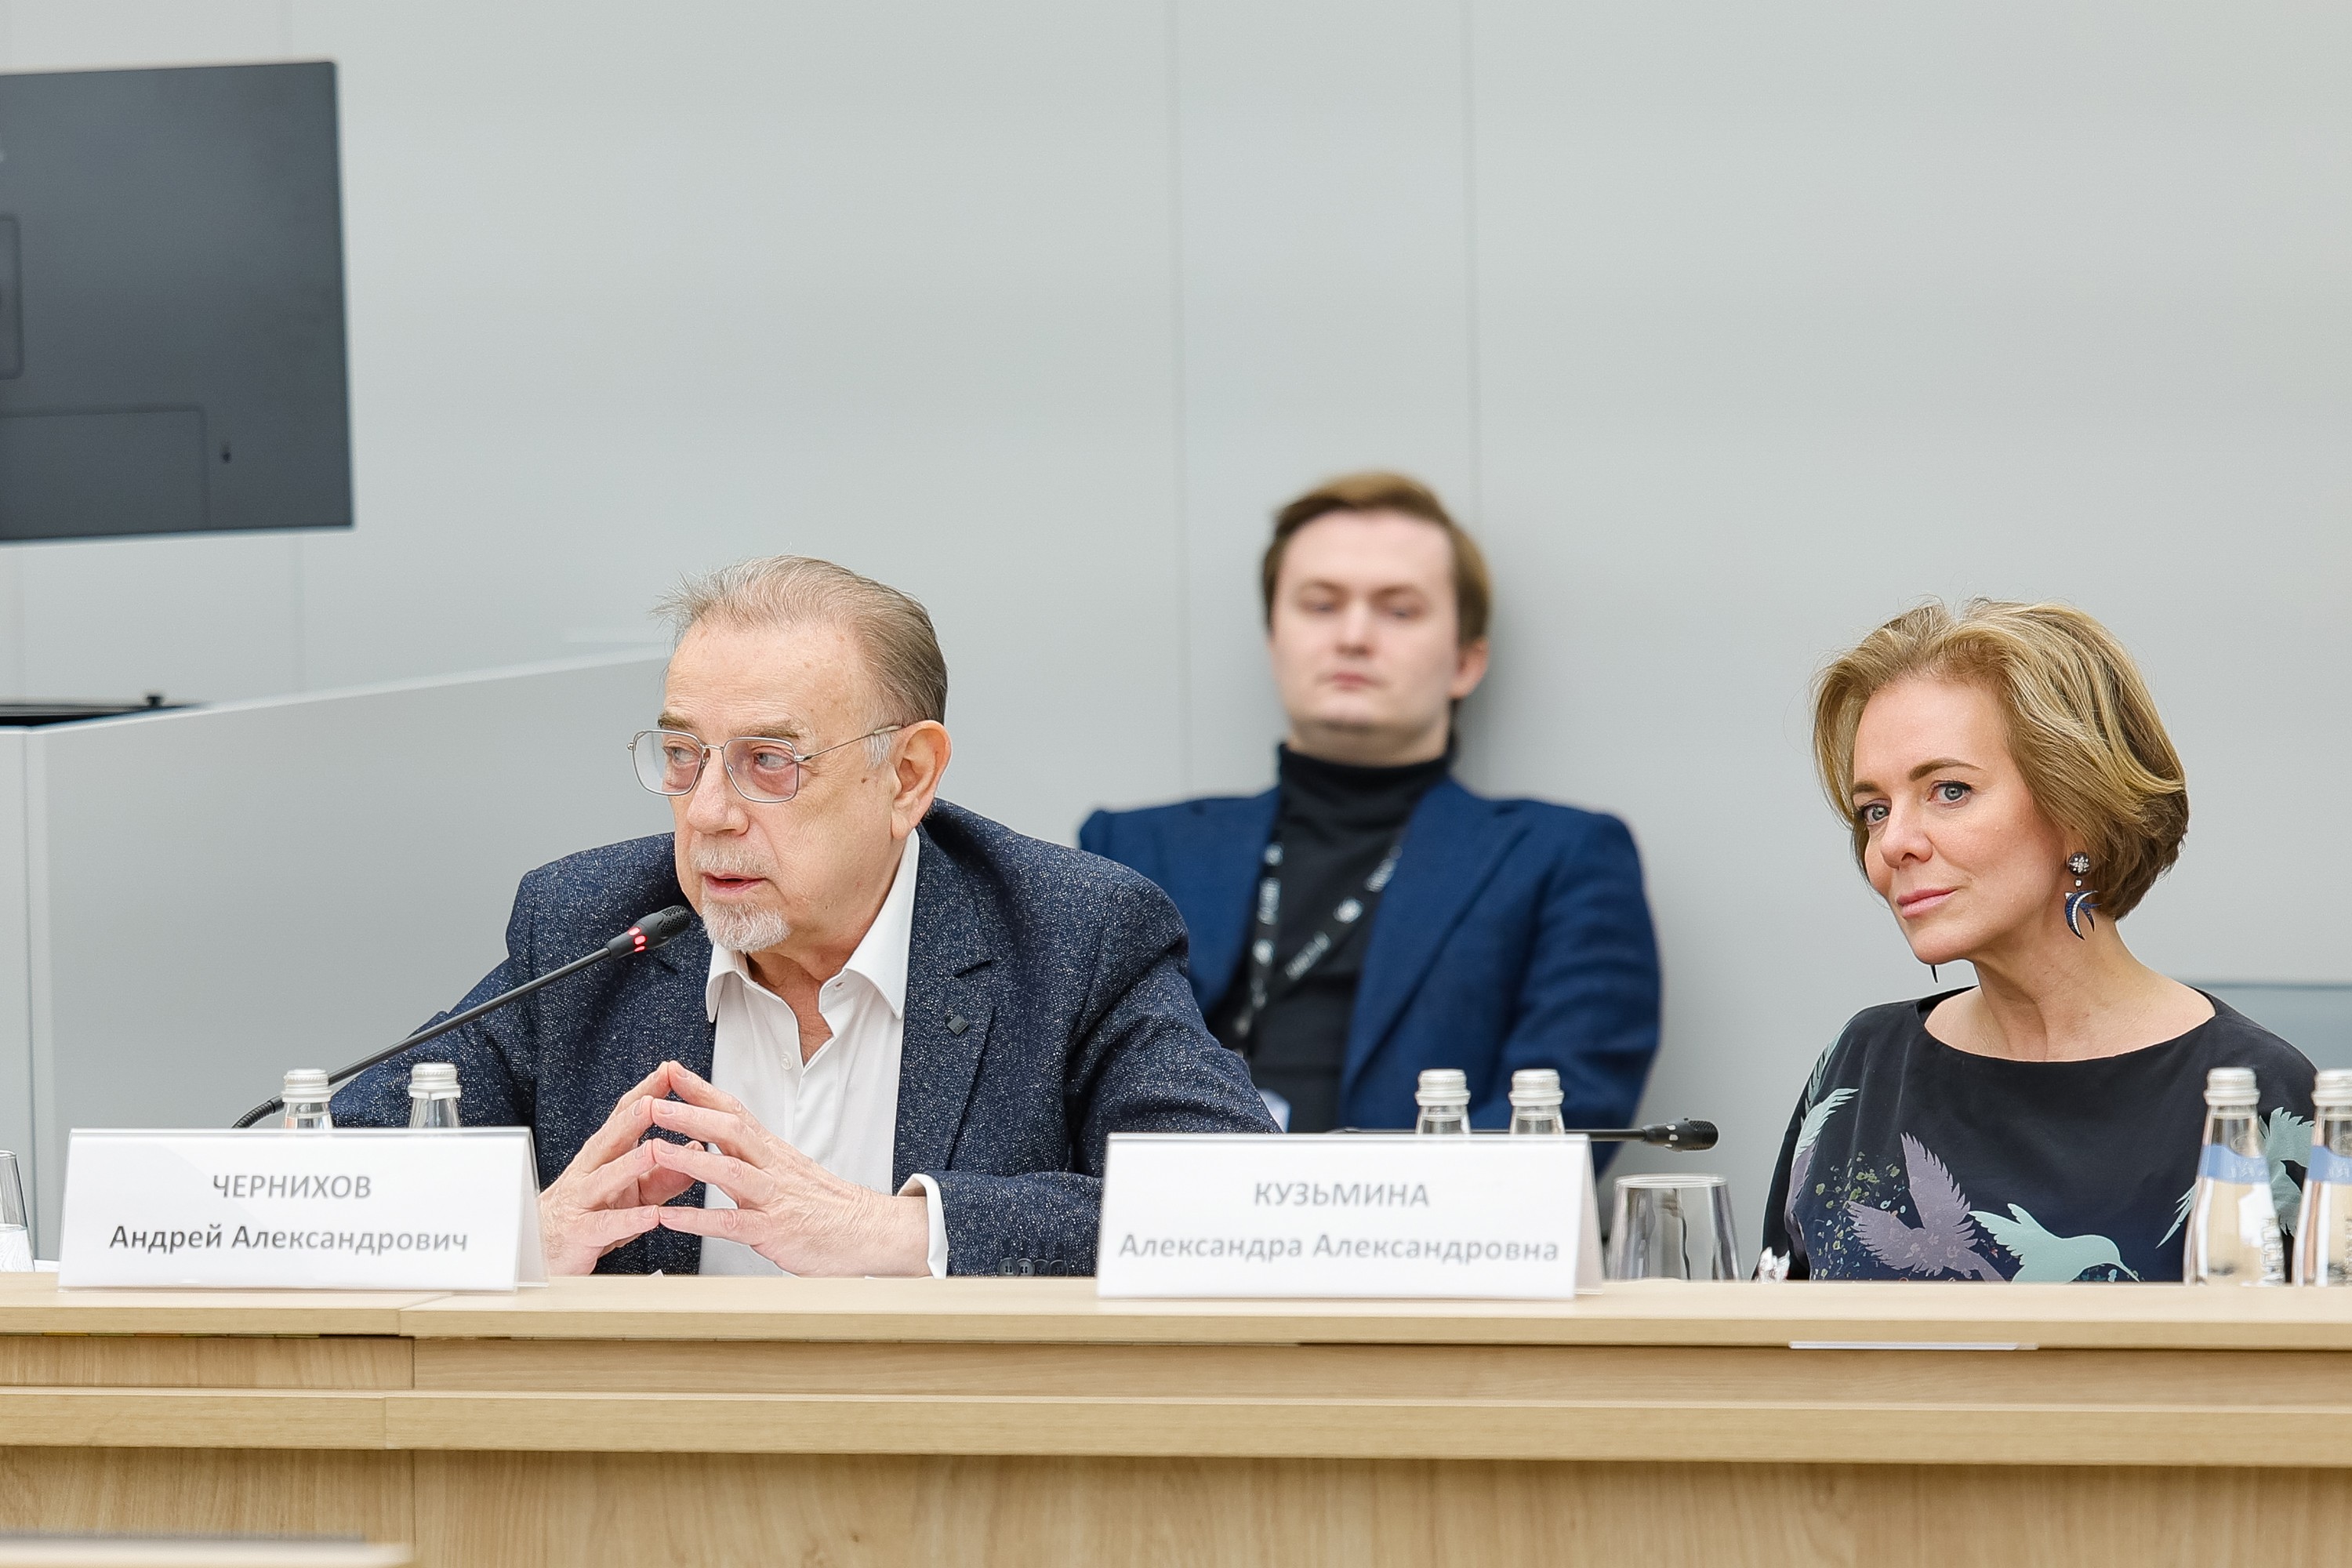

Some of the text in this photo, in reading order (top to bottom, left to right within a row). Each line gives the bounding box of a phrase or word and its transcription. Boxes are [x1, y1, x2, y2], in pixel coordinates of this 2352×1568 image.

[212, 1174, 372, 1199] ЧЕРНИХОВ
[1254, 1182, 1429, 1207] КУЗЬМИНА
[109, 1223, 468, 1256] Андрей Александрович
[1119, 1233, 1558, 1264] Александра Александровна
